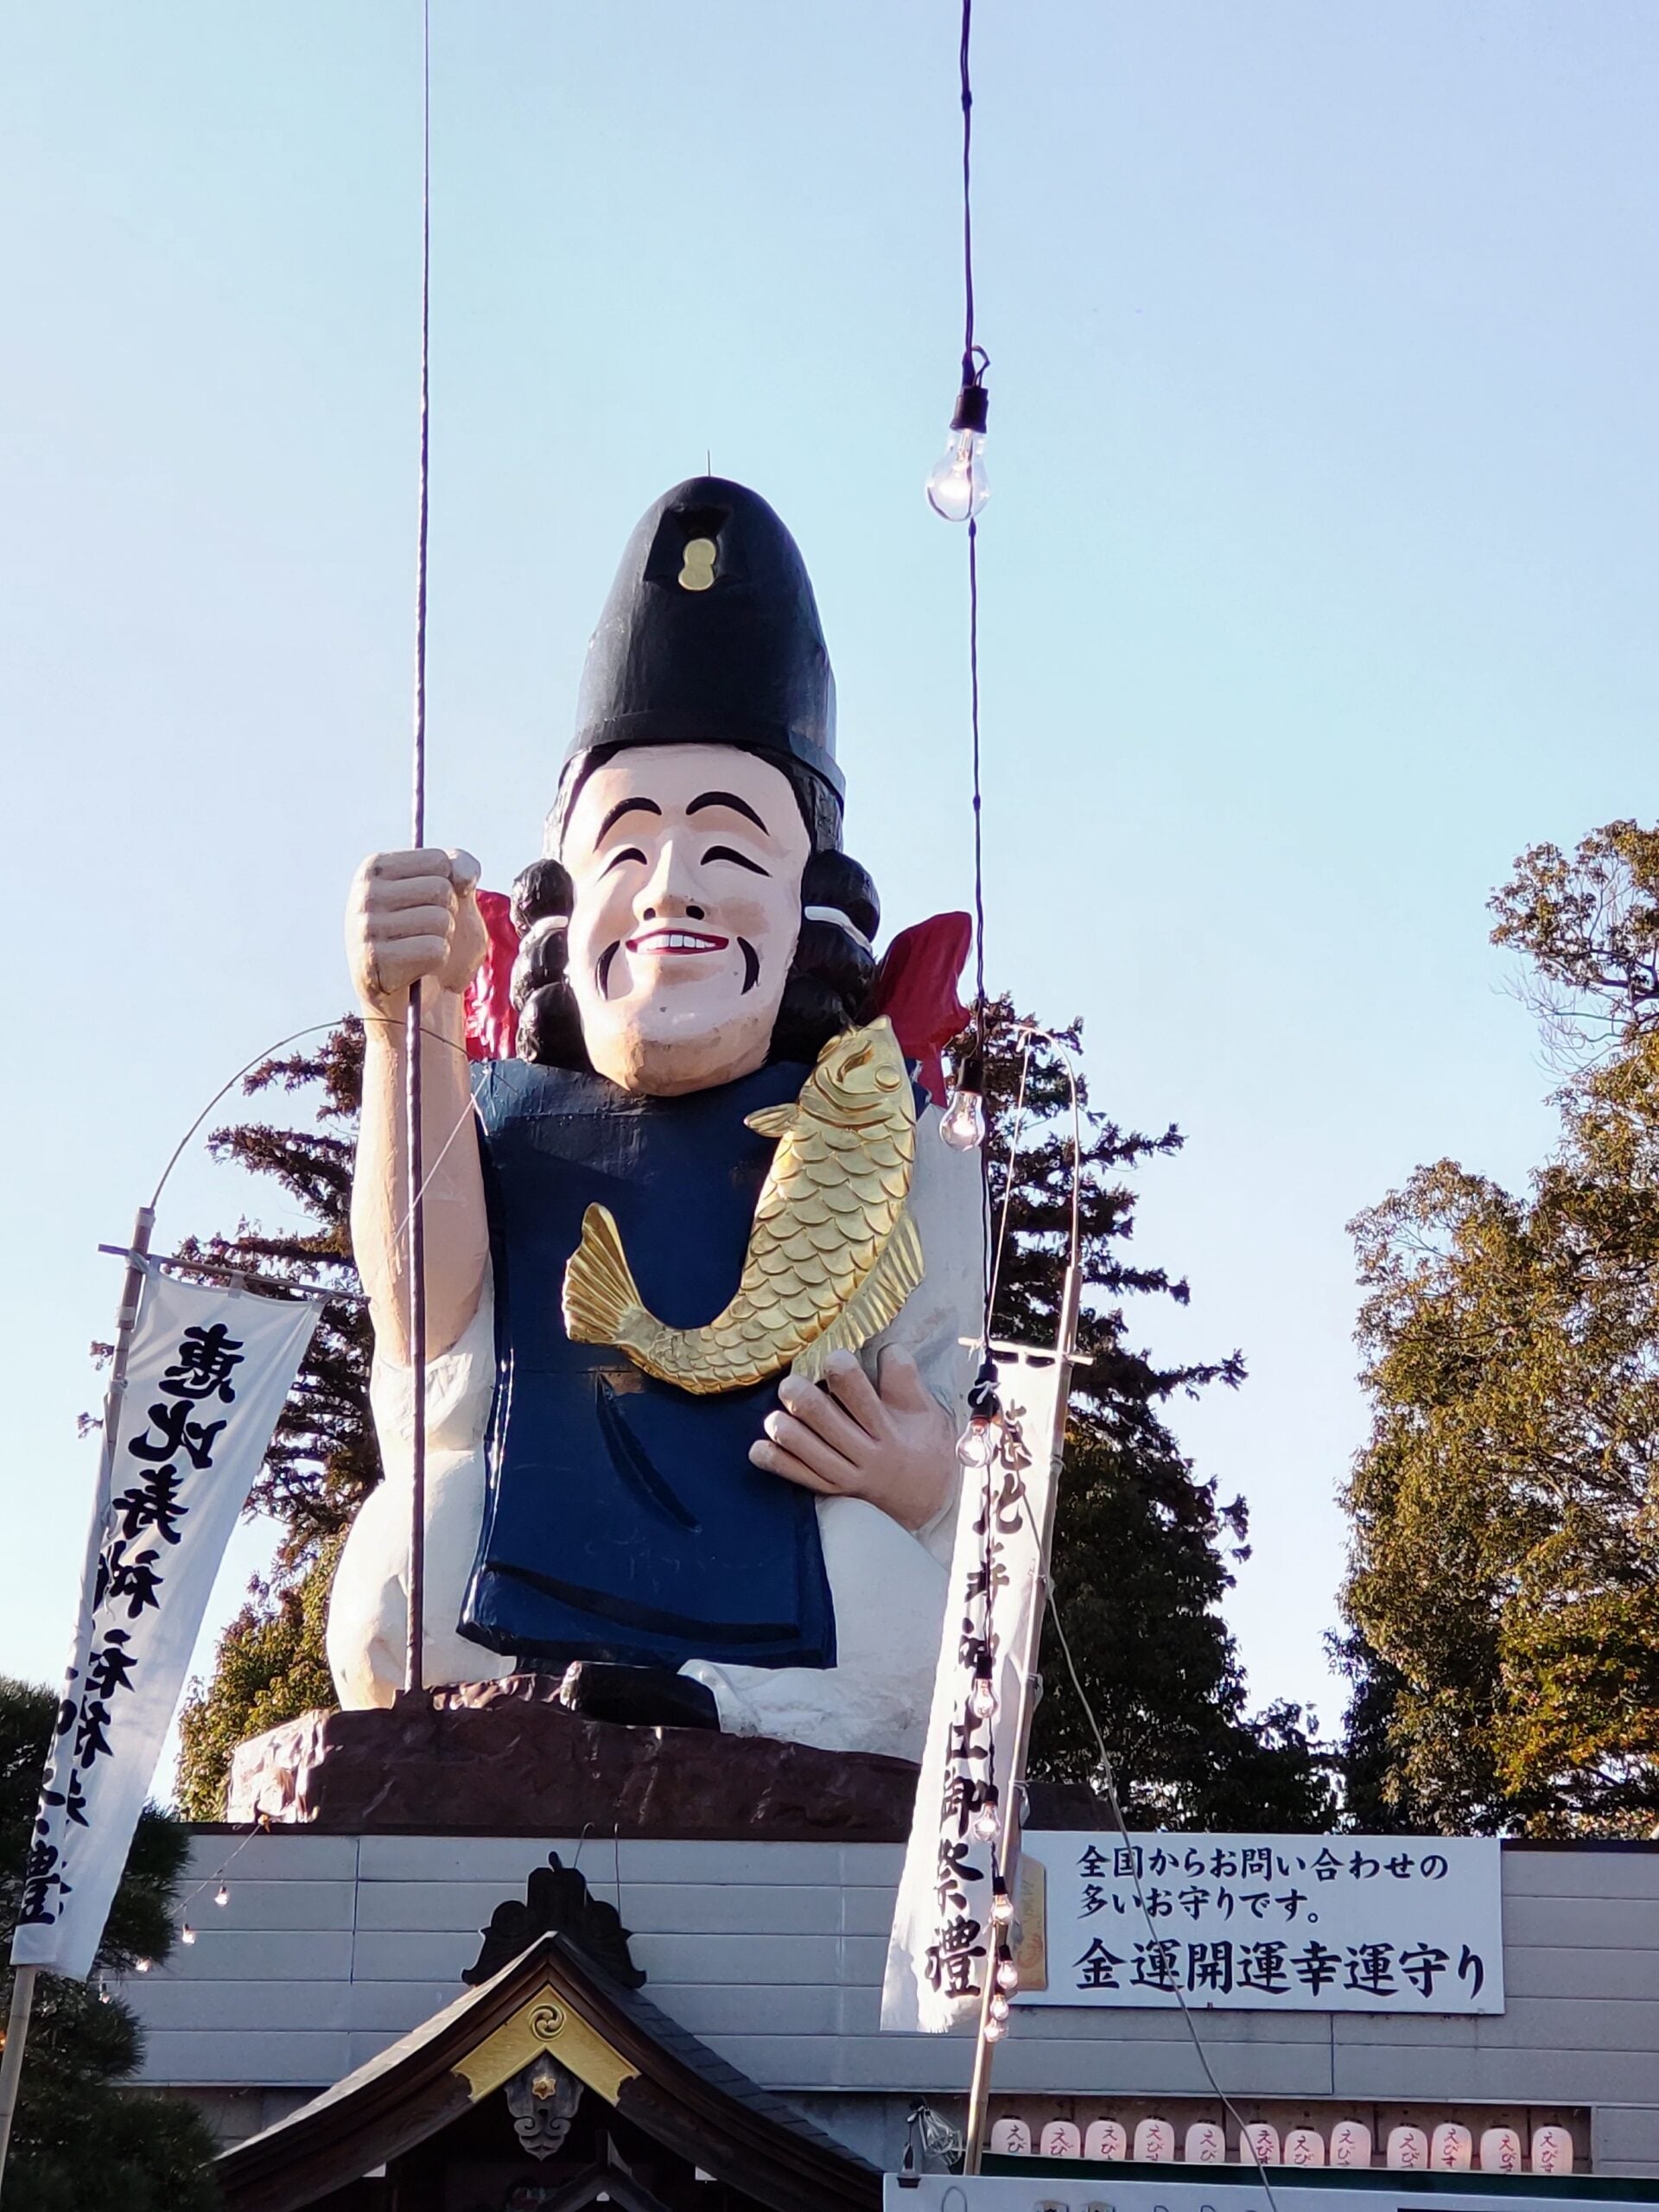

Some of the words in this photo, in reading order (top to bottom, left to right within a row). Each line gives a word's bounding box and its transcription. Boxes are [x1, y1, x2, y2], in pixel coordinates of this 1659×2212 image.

[1077, 1845, 1449, 1882] 全国からお問い合わせの
[1077, 1885, 1321, 1924] 多いお守りです。
[1071, 1936, 1484, 1998] 金運開運幸運守り
[1101, 2126, 1118, 2159] えび
